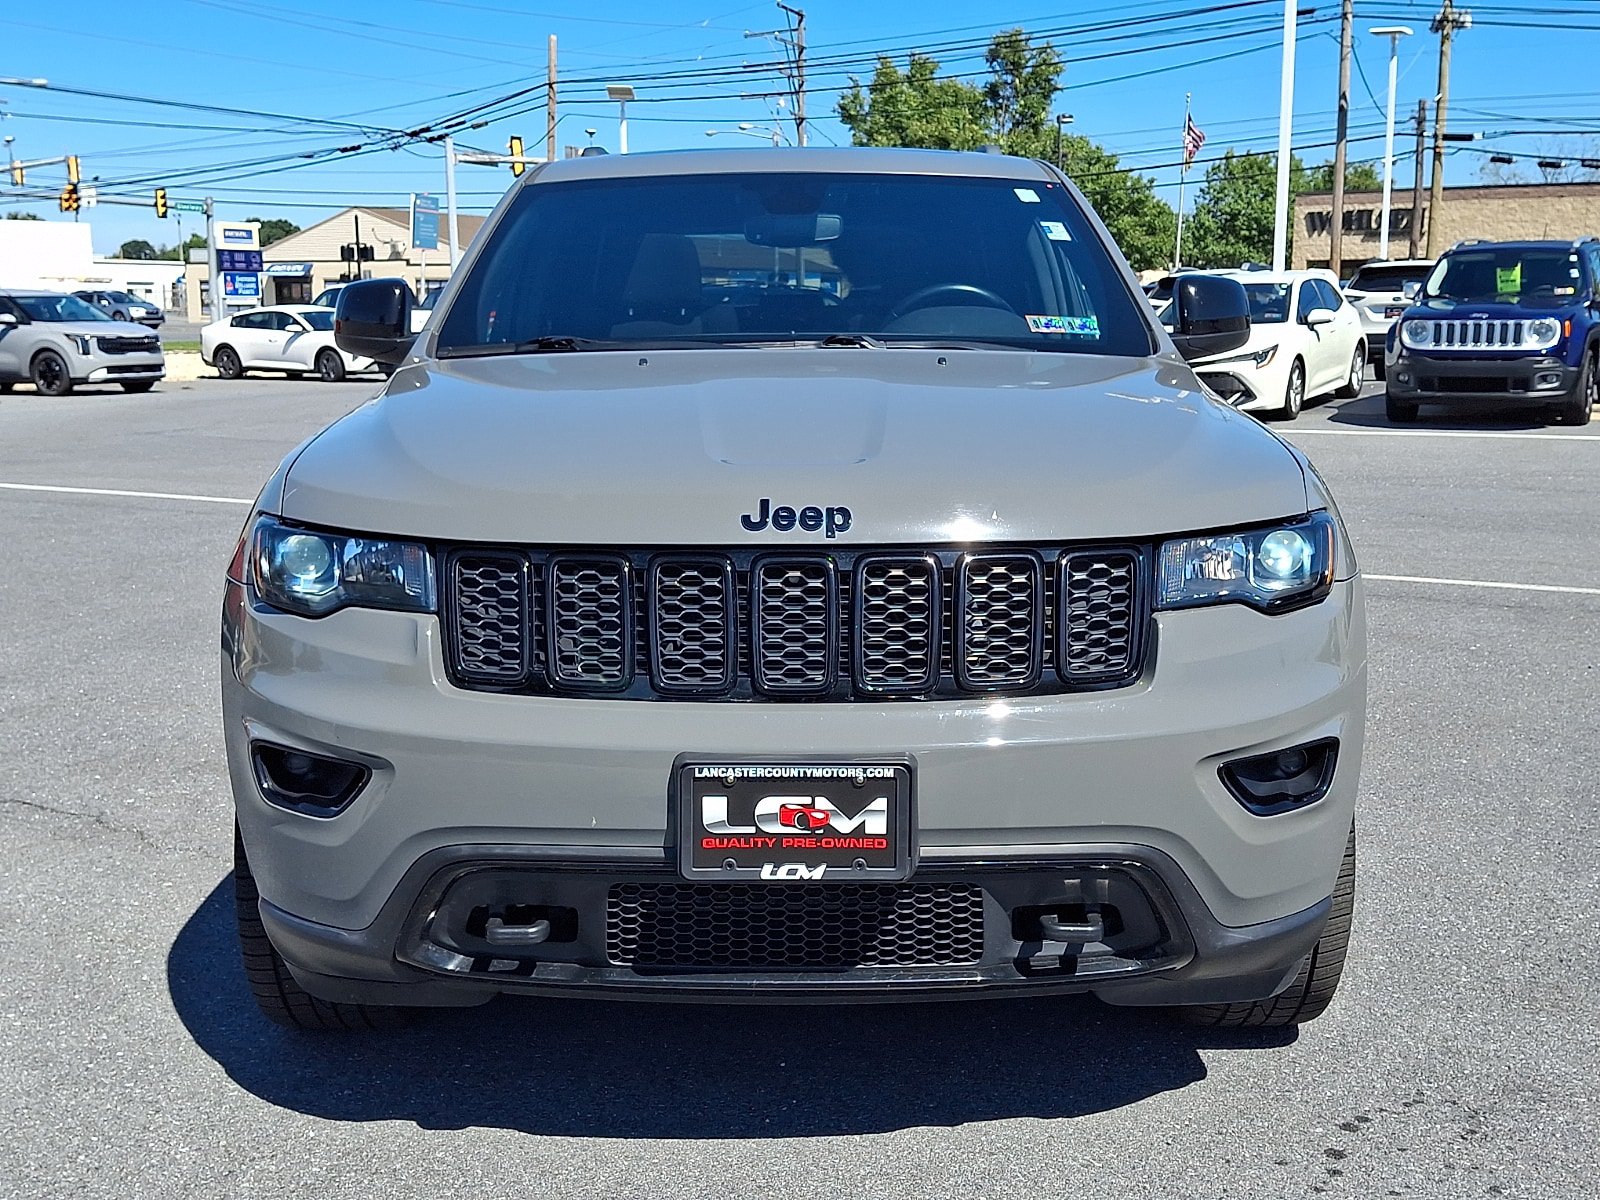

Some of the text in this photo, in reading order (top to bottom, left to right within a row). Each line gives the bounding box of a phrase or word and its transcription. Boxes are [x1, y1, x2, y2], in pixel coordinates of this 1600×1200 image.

[740, 498, 852, 538] Jeep
[694, 767, 895, 778] LANCASTERCOUNTYMOTORS.COM
[702, 838, 888, 849] QUALITY PRE-OWNED
[760, 863, 827, 880] LCM
